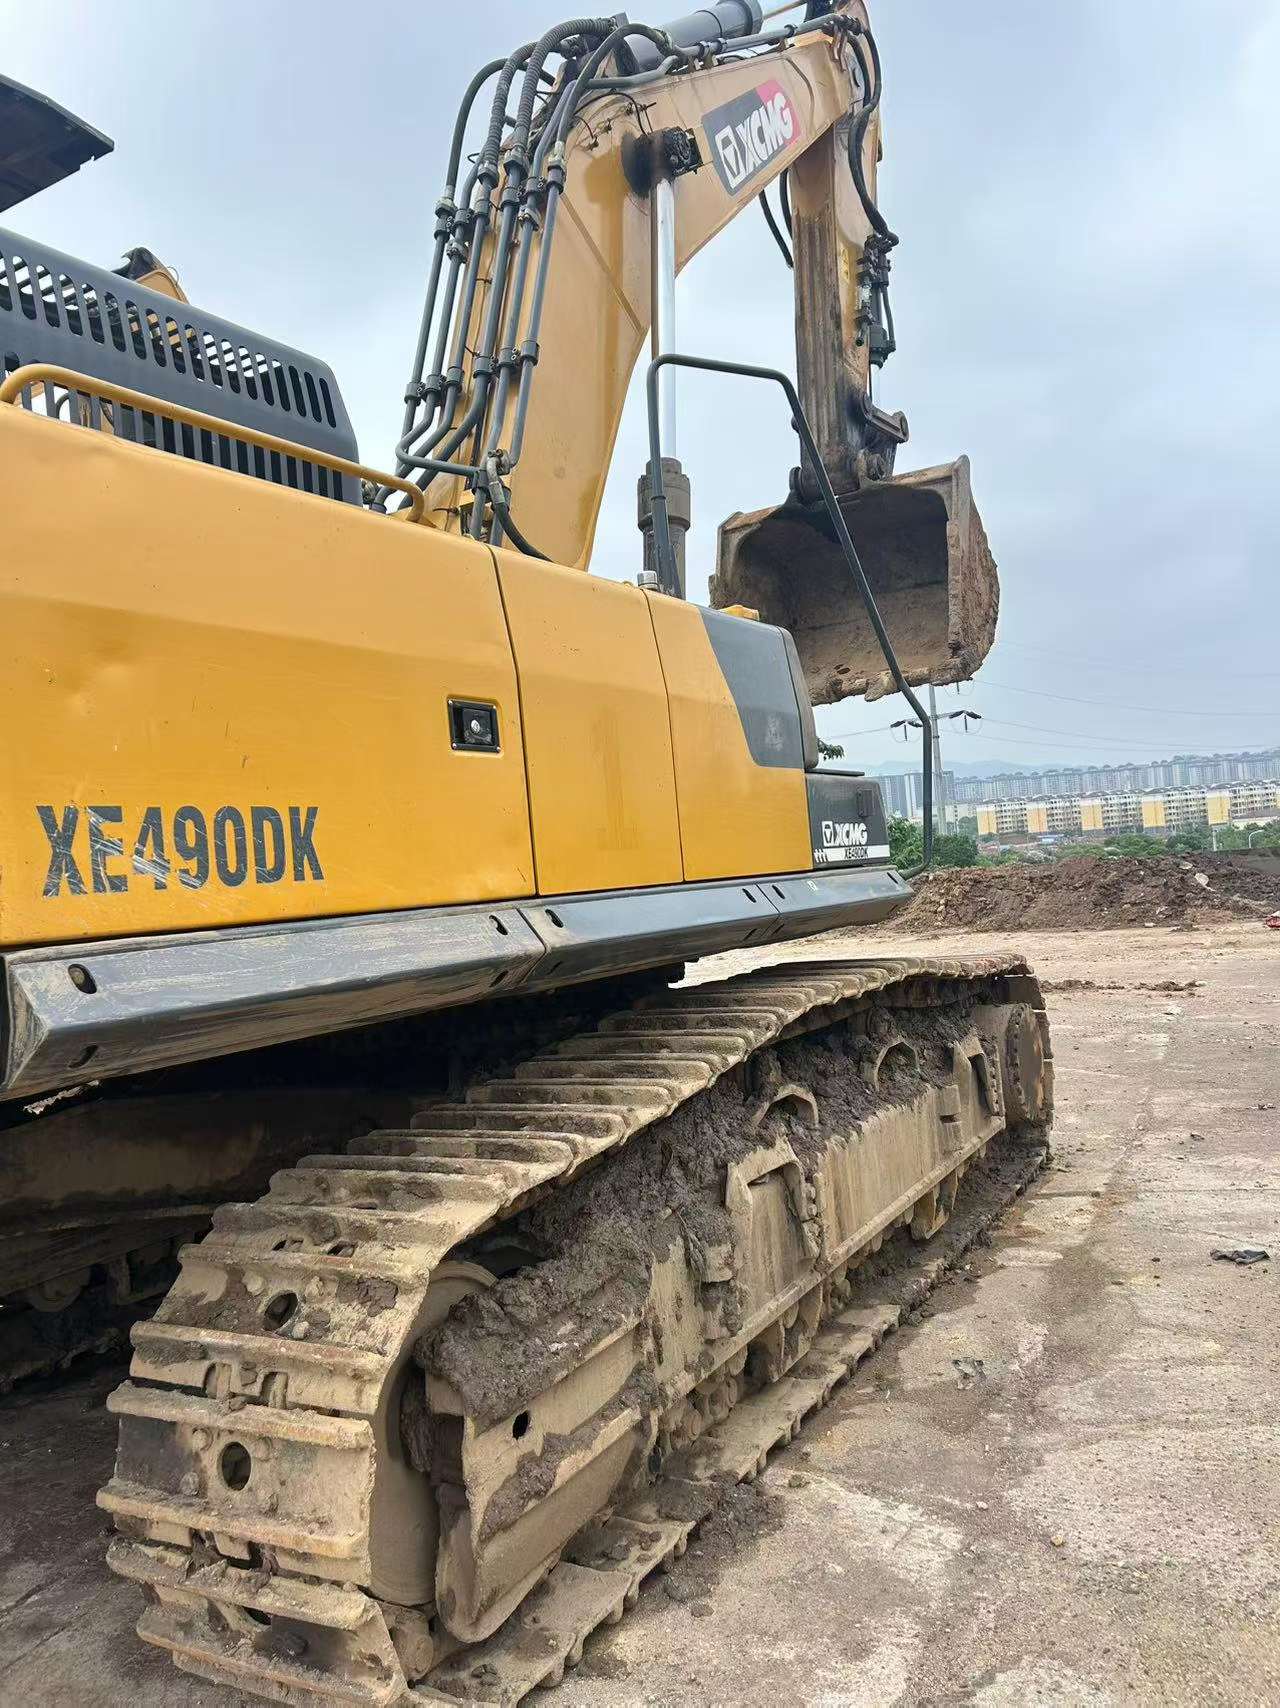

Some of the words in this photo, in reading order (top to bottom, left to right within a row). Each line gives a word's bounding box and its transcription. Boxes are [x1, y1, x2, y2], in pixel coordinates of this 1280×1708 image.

[735, 92, 793, 175] XCMG
[36, 804, 325, 897] XE490DK
[834, 822, 868, 846] XCMG
